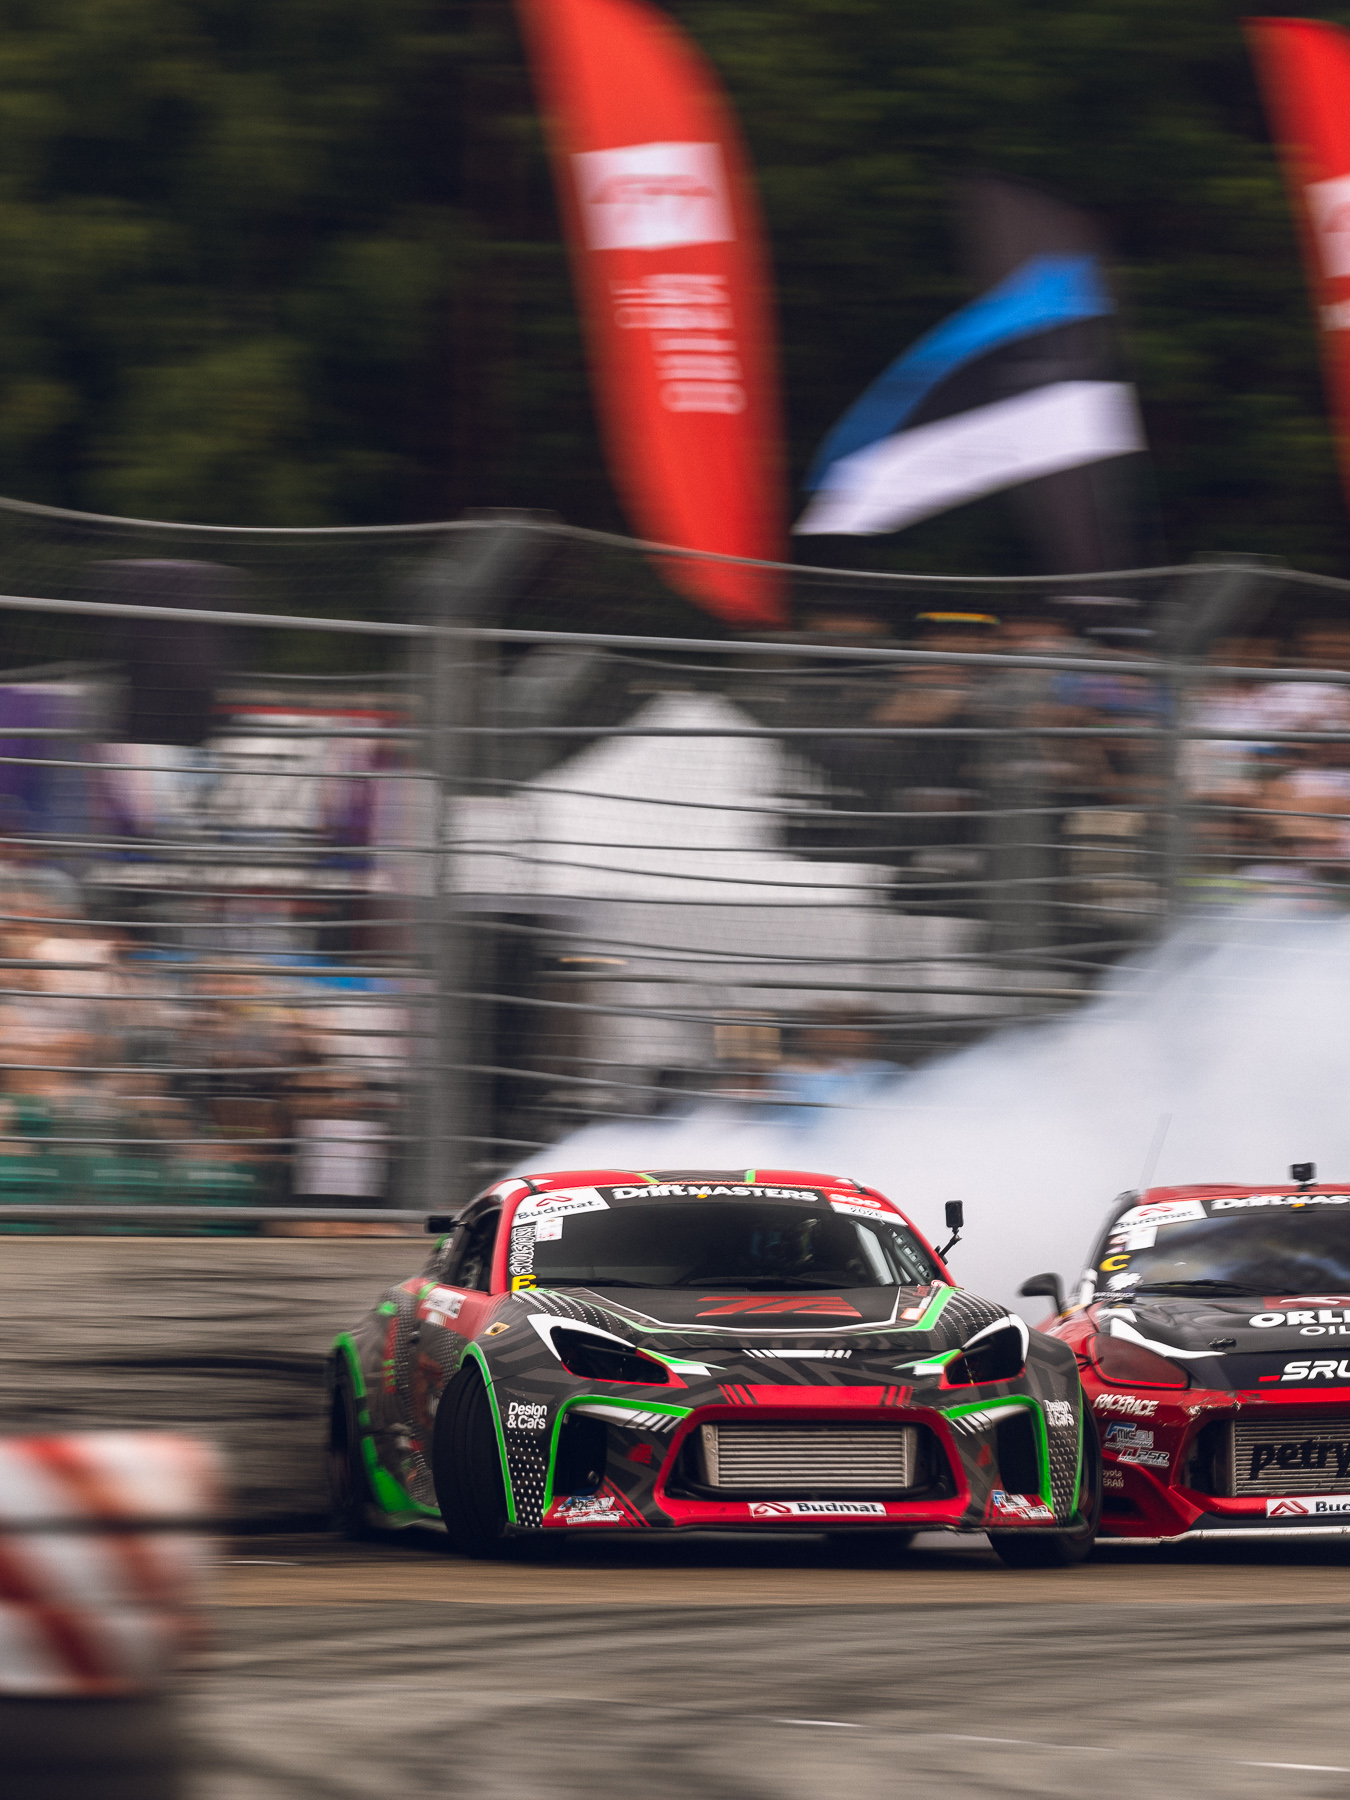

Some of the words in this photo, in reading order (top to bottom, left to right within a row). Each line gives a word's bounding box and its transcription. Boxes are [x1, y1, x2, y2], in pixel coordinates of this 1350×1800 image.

[508, 1402, 547, 1418] Design
[507, 1415, 517, 1428] &
[518, 1415, 546, 1429] Cars
[797, 1502, 884, 1513] Budmat.
